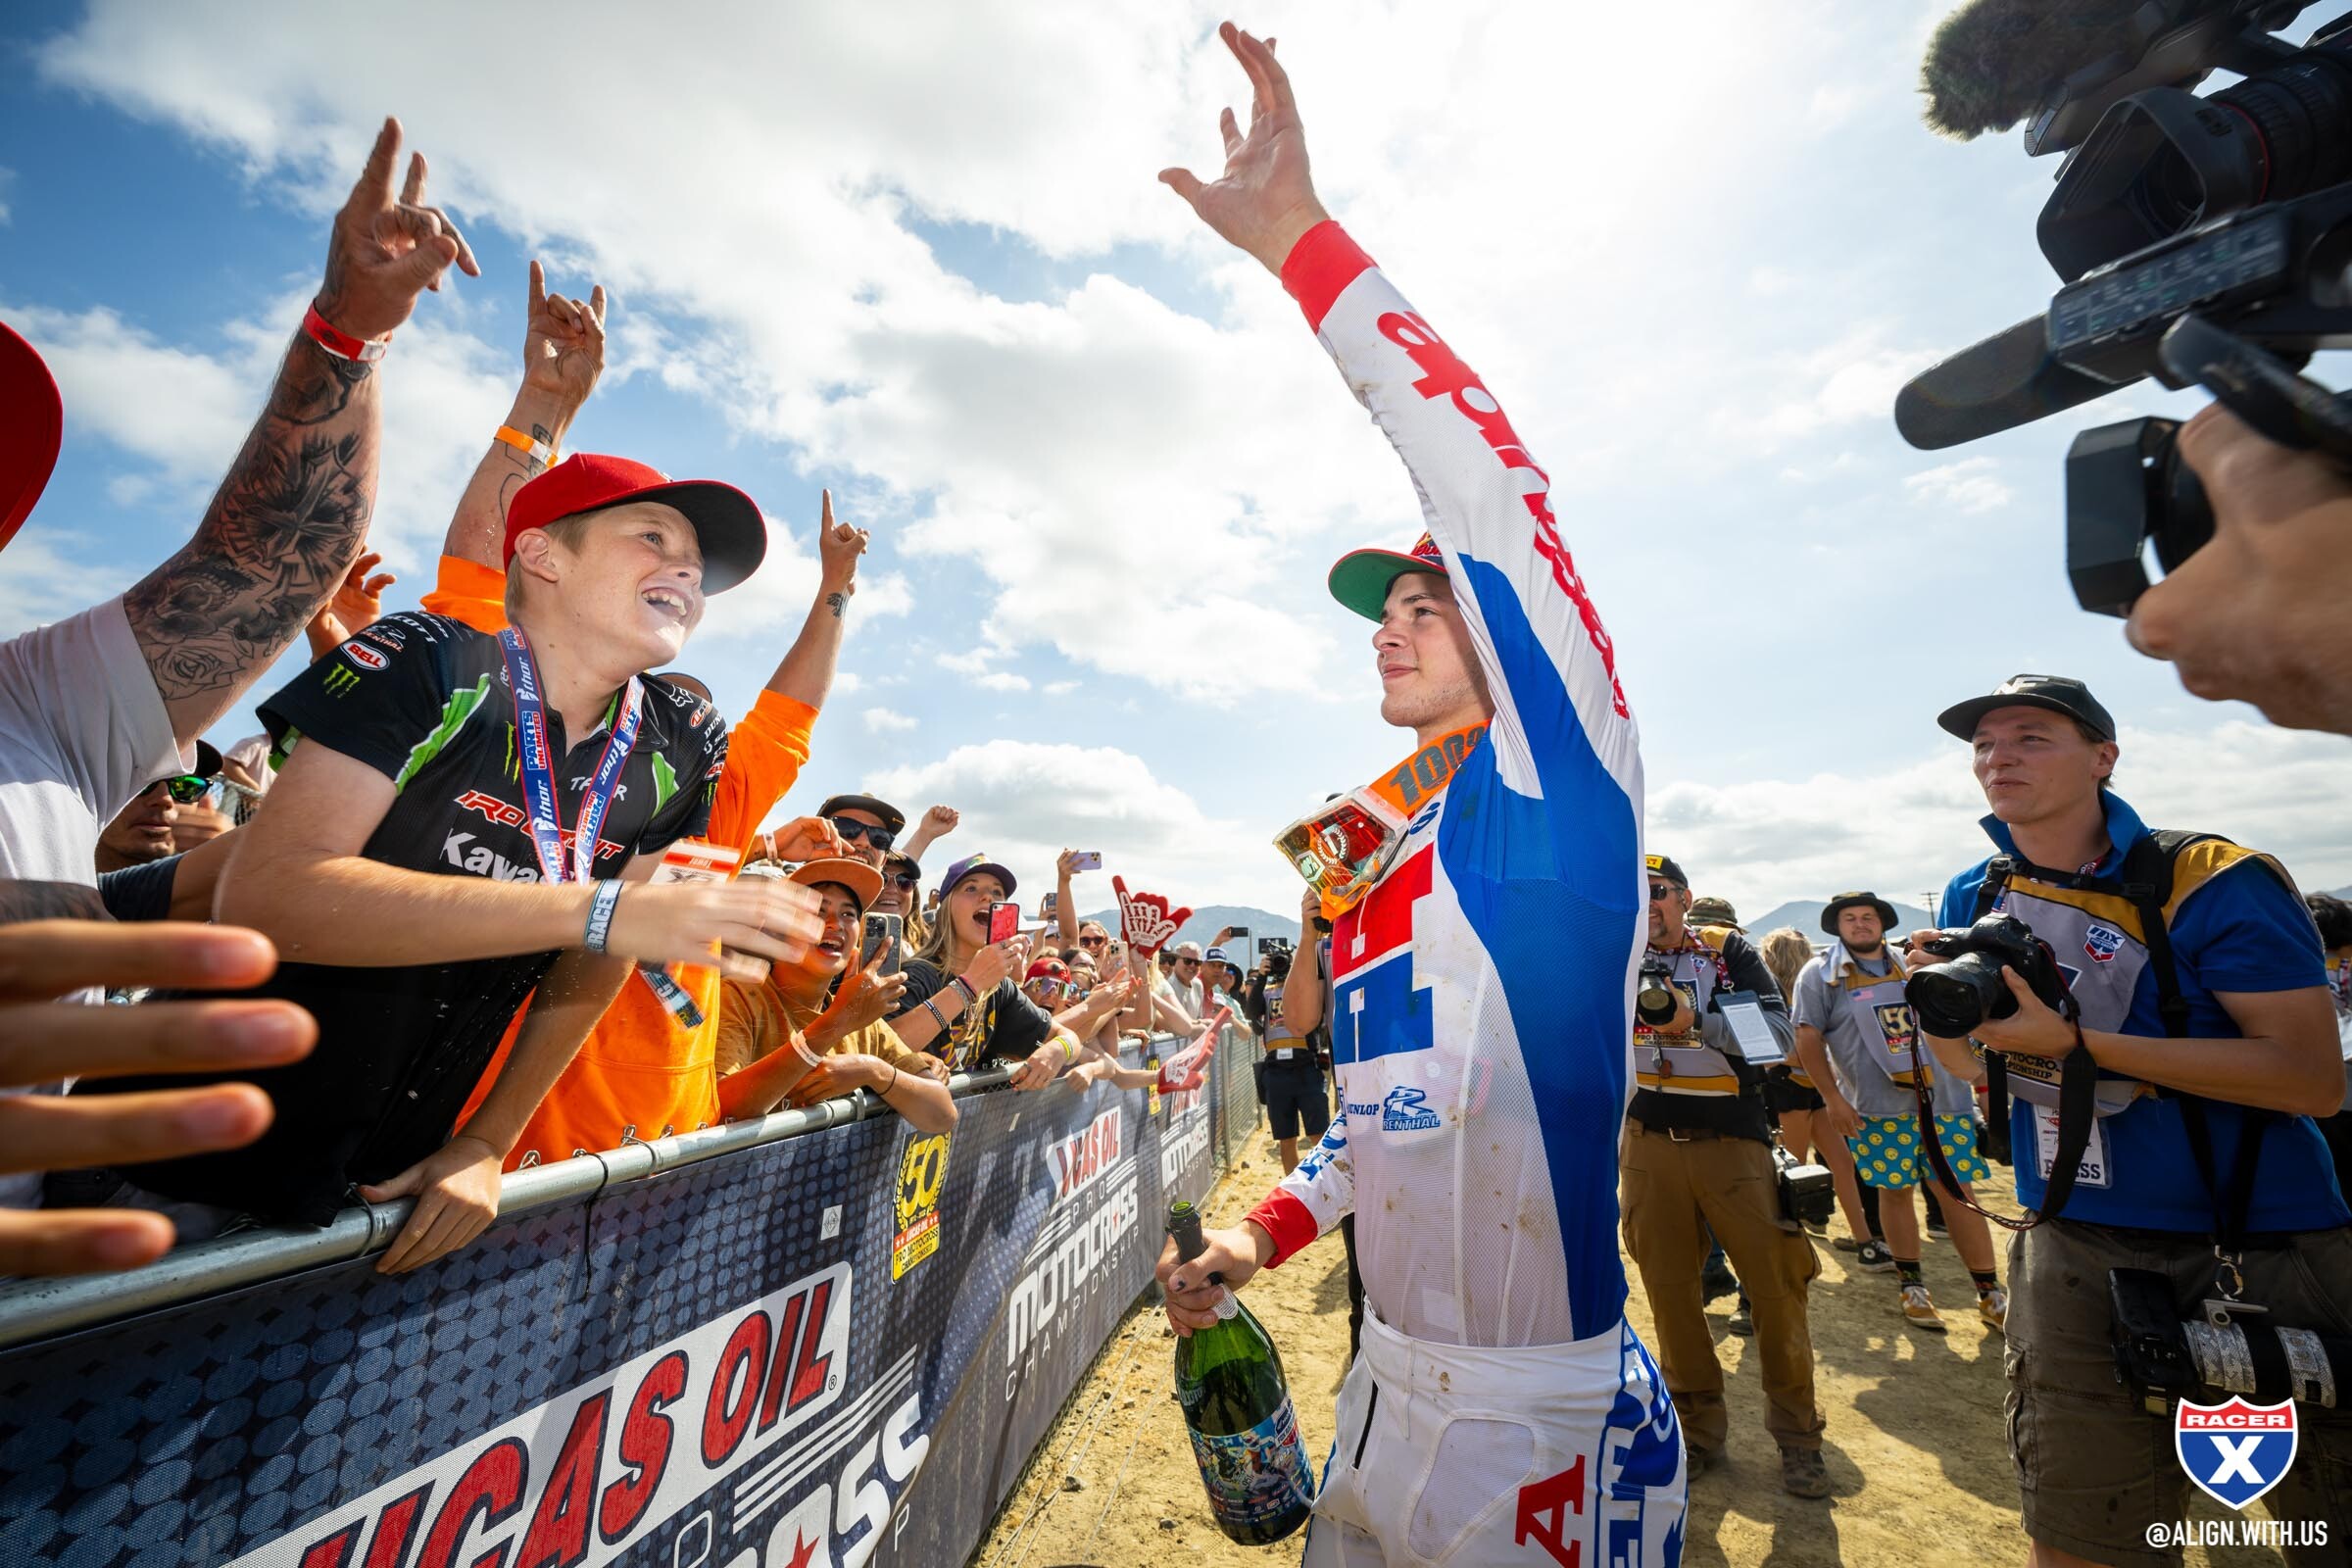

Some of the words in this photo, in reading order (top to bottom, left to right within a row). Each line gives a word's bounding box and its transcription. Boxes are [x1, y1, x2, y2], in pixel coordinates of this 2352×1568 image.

[348, 644, 381, 668] BELL
[518, 657, 534, 692] thor
[522, 711, 538, 769] PARTS
[533, 711, 547, 769] UNLIMITED
[601, 749, 619, 785] thor
[538, 779, 553, 825] thor
[579, 791, 597, 841] UNLIMITED
[586, 793, 606, 847] PARTS
[1102, 1112, 1118, 1167] OIL
[1383, 1114, 1441, 1131] RENTHAL
[901, 1135, 946, 1217] 50
[2044, 1158, 2101, 1180] PSS
[1073, 1181, 1104, 1224] PRO
[895, 1248, 908, 1263] PRO
[907, 1226, 939, 1255] MOTOCROSS
[1007, 1175, 1138, 1367] MOTOCROSS
[1005, 1225, 1139, 1401] CHAMPIONSHIP
[701, 1276, 835, 1470] OIL
